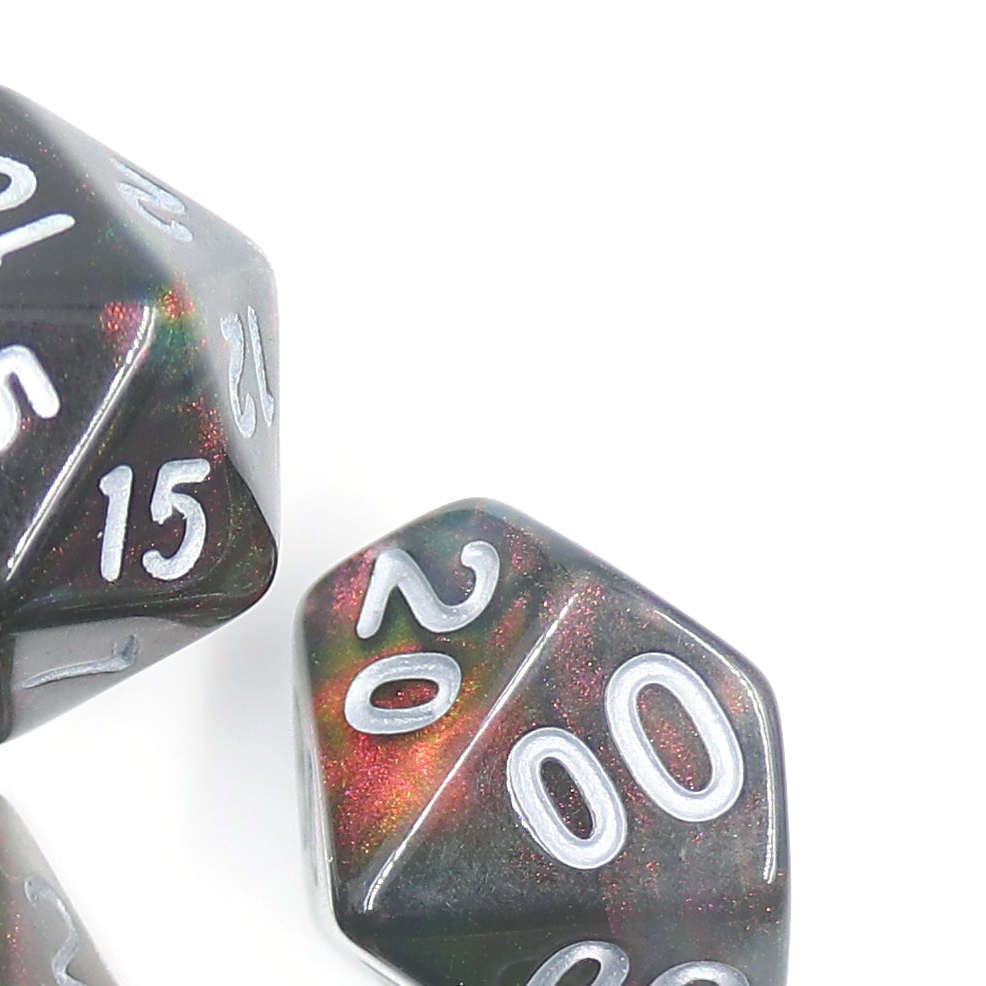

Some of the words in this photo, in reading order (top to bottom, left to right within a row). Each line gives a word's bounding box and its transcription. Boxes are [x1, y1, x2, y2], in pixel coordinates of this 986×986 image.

[220, 305, 274, 438] 12
[98, 458, 211, 581] 15
[344, 541, 500, 735] 20
[505, 651, 744, 870] 00
